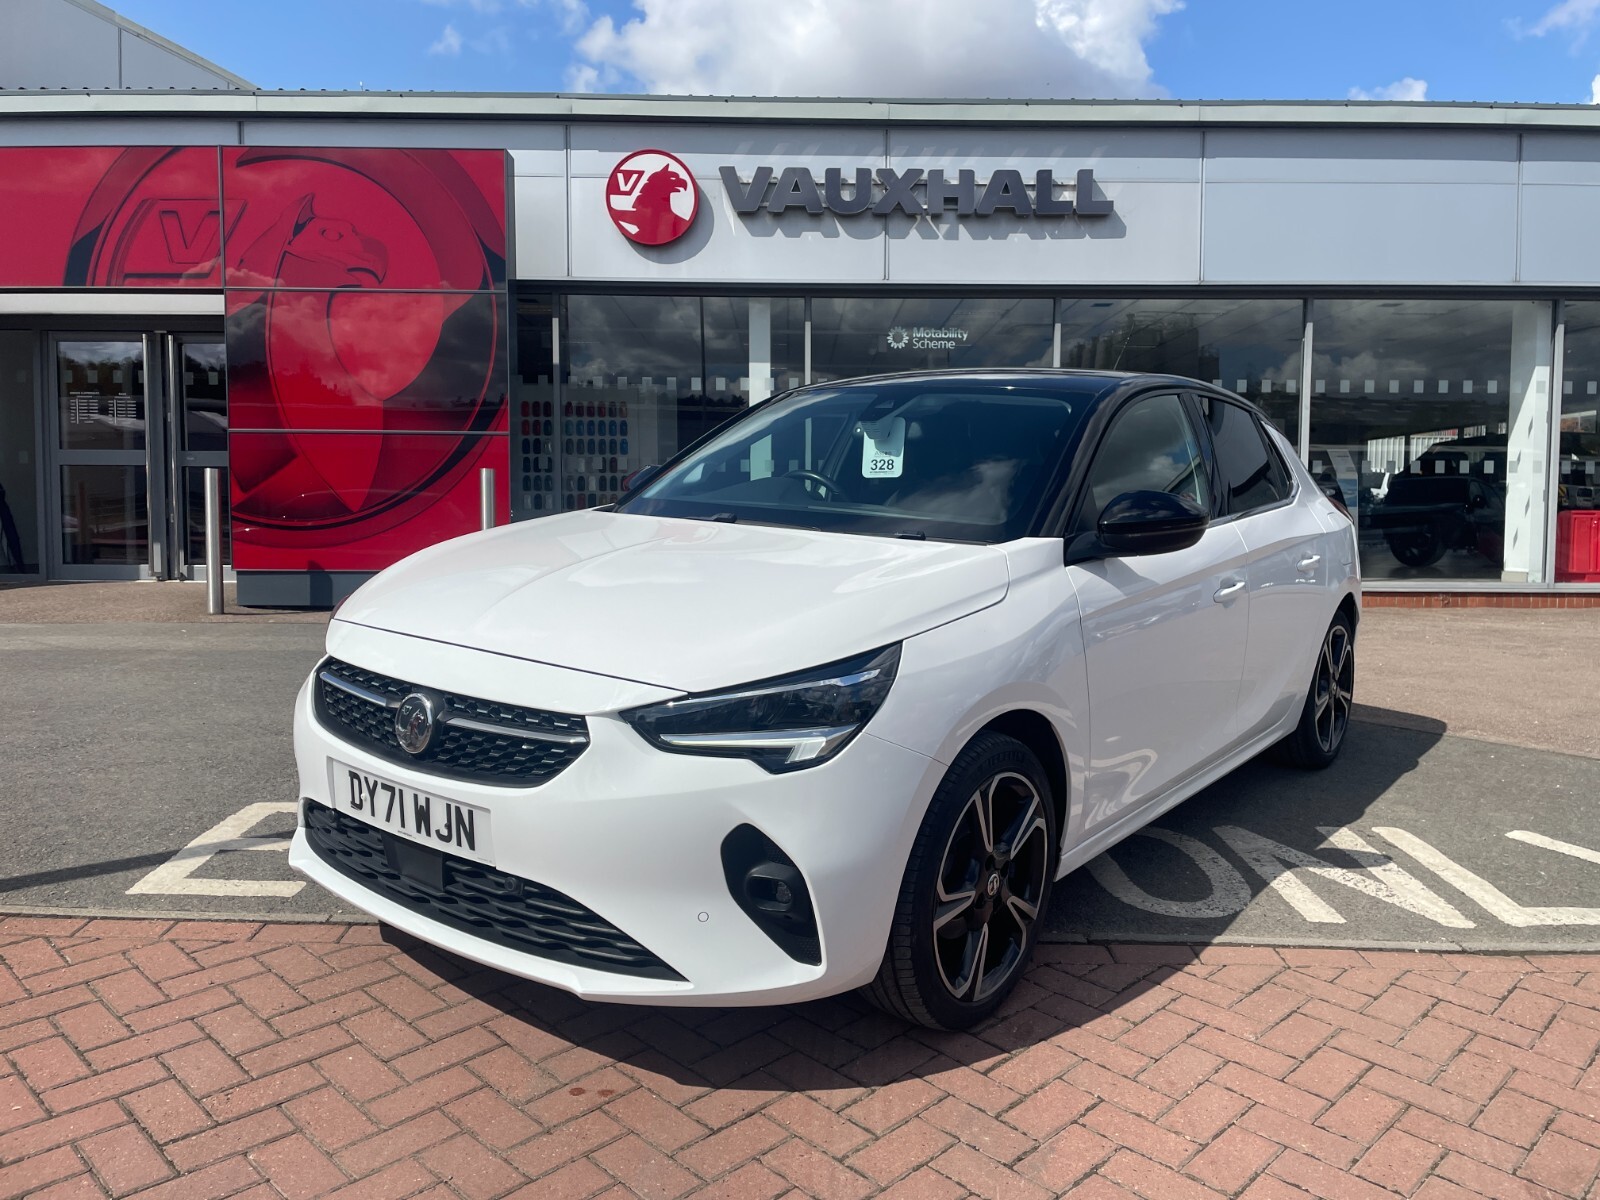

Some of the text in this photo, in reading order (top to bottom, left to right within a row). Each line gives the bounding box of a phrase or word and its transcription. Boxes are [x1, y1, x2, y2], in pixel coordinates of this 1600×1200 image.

[718, 166, 1114, 216] VAUXHALL
[912, 327, 969, 341] Motability
[912, 338, 956, 349] Scheme
[870, 458, 895, 471] 328
[348, 769, 476, 852] DY71 WJN
